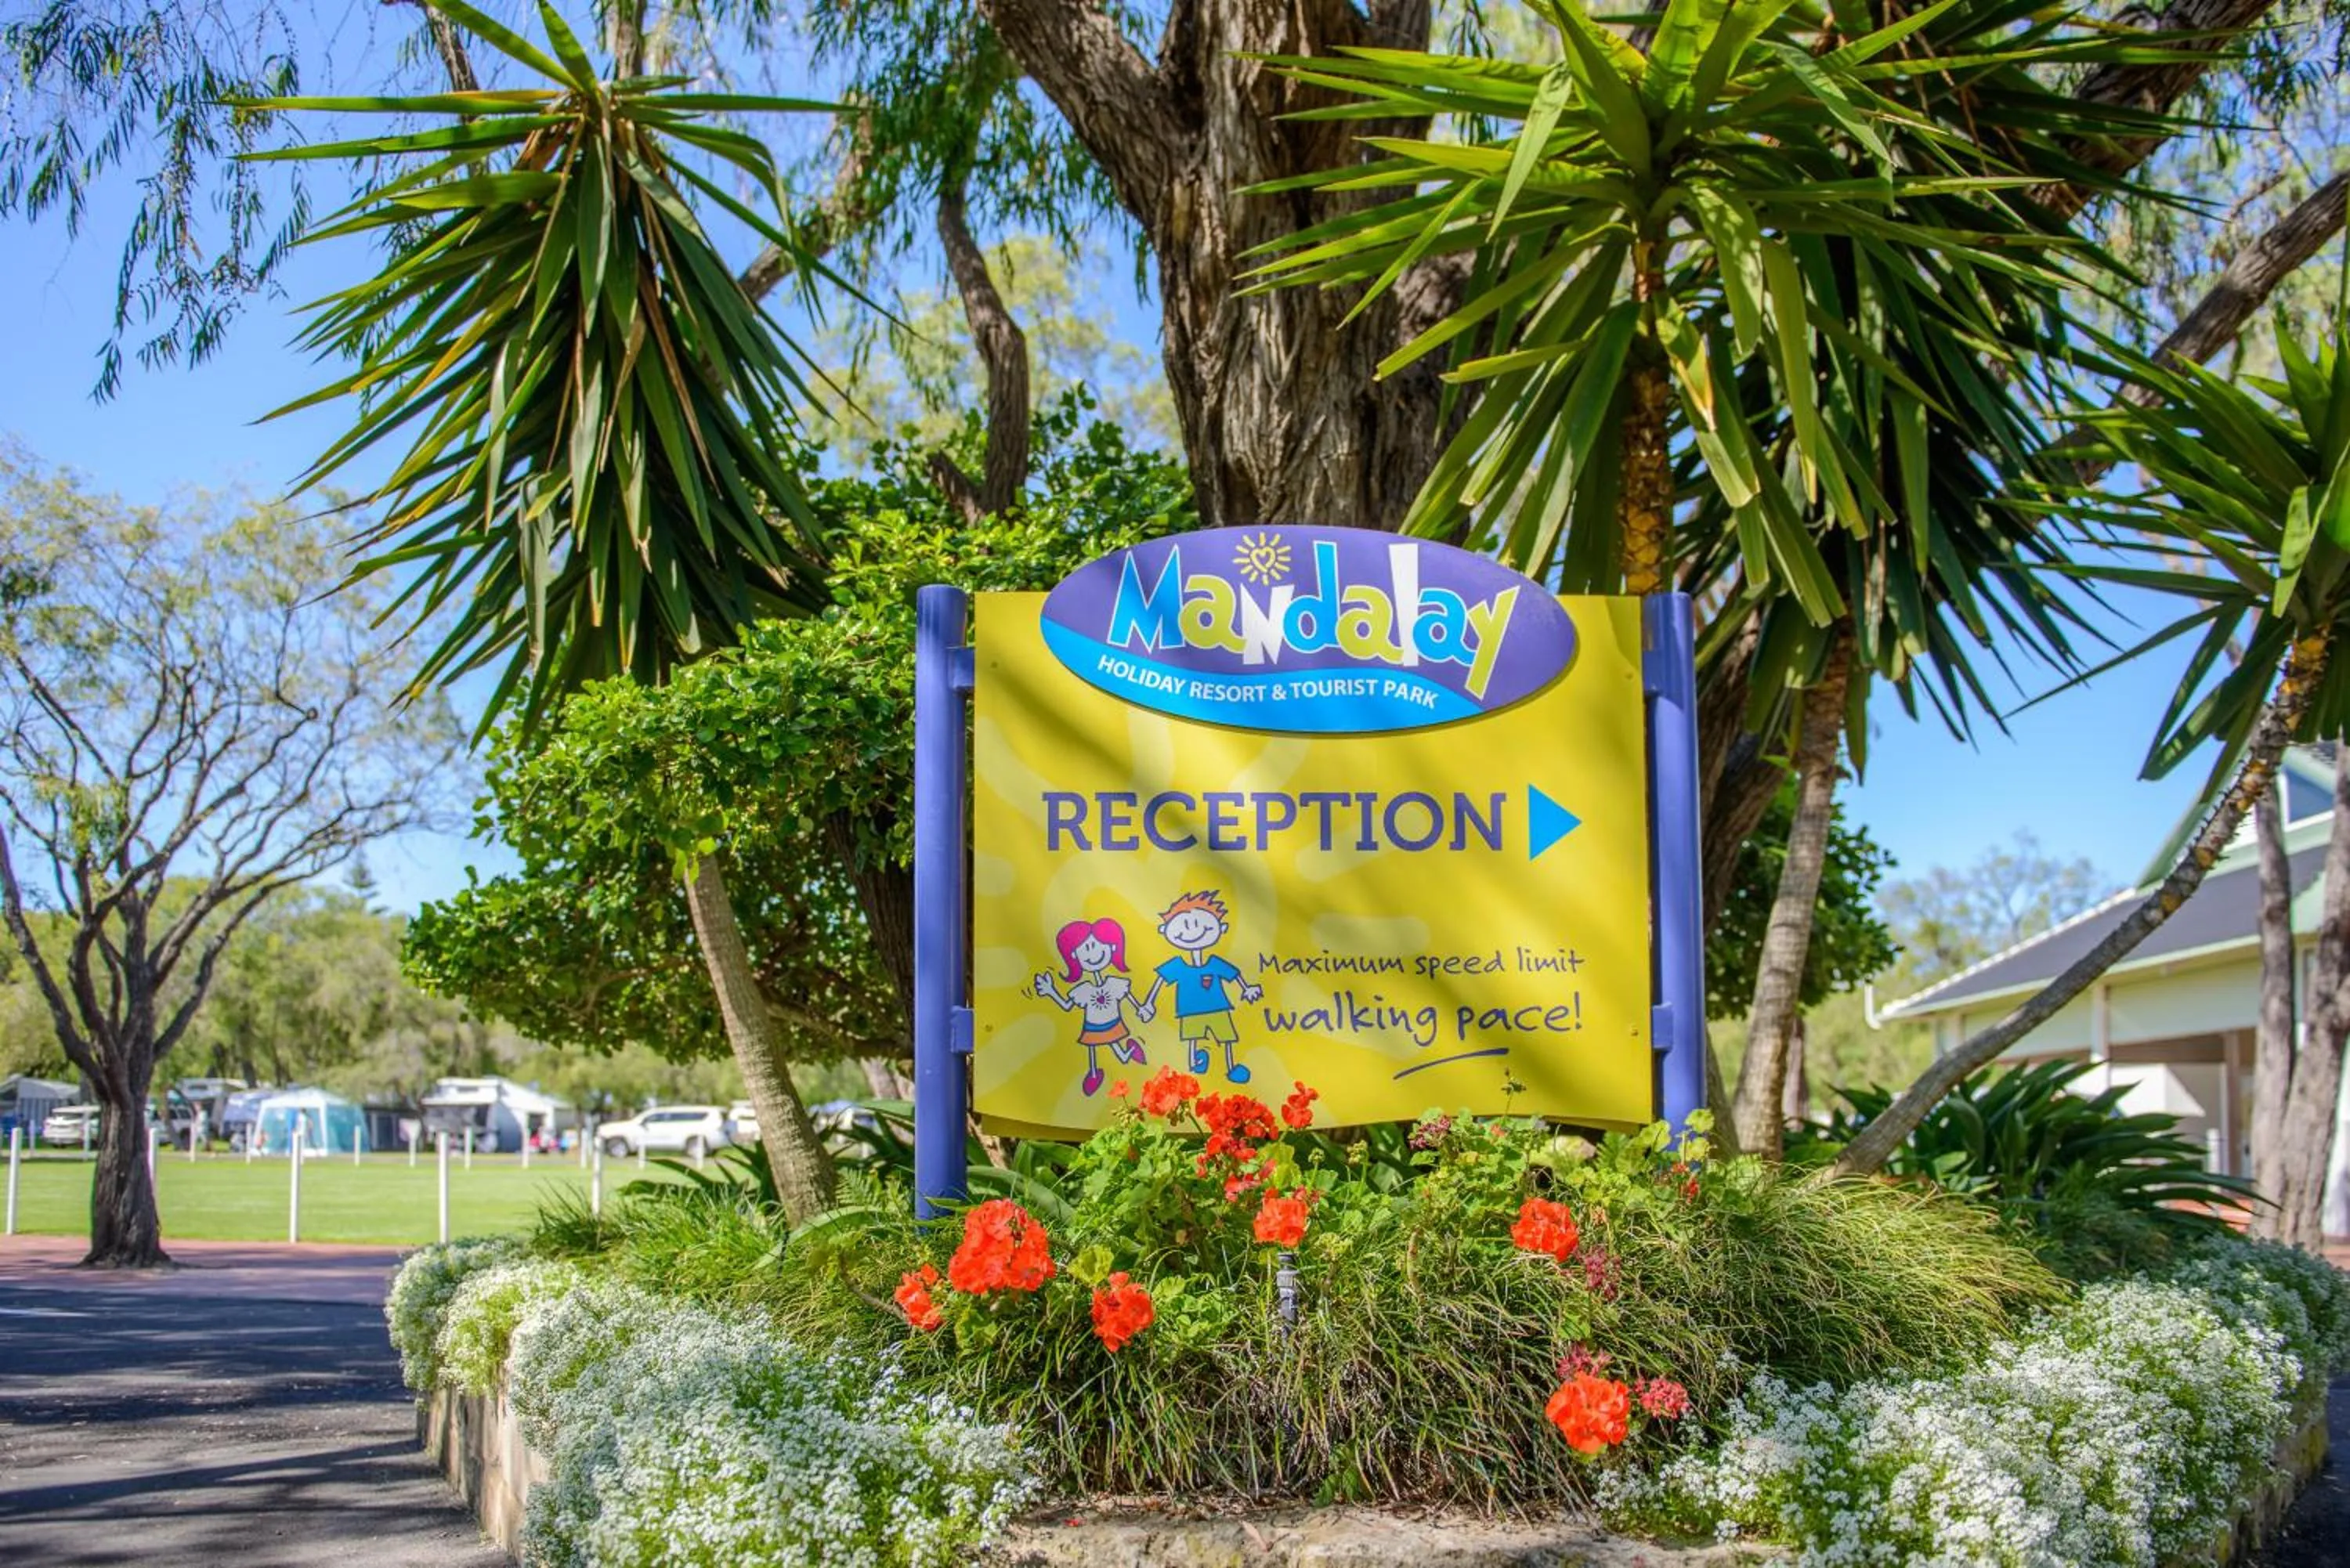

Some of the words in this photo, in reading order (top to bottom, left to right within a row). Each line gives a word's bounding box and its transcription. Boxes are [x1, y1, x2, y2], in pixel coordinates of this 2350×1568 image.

[1098, 655, 1186, 695] HOLIDAY
[1189, 681, 1267, 702] RESORT
[1271, 683, 1287, 701] &
[1289, 679, 1378, 699] TOURIST
[1383, 681, 1438, 708] PARK
[1042, 791, 1506, 852] RECEPTION
[1258, 952, 1404, 975] Maximum
[1415, 950, 1505, 979] speed
[1517, 947, 1585, 973] limit
[1264, 991, 1438, 1046] walking
[1456, 990, 1582, 1038] pace!
